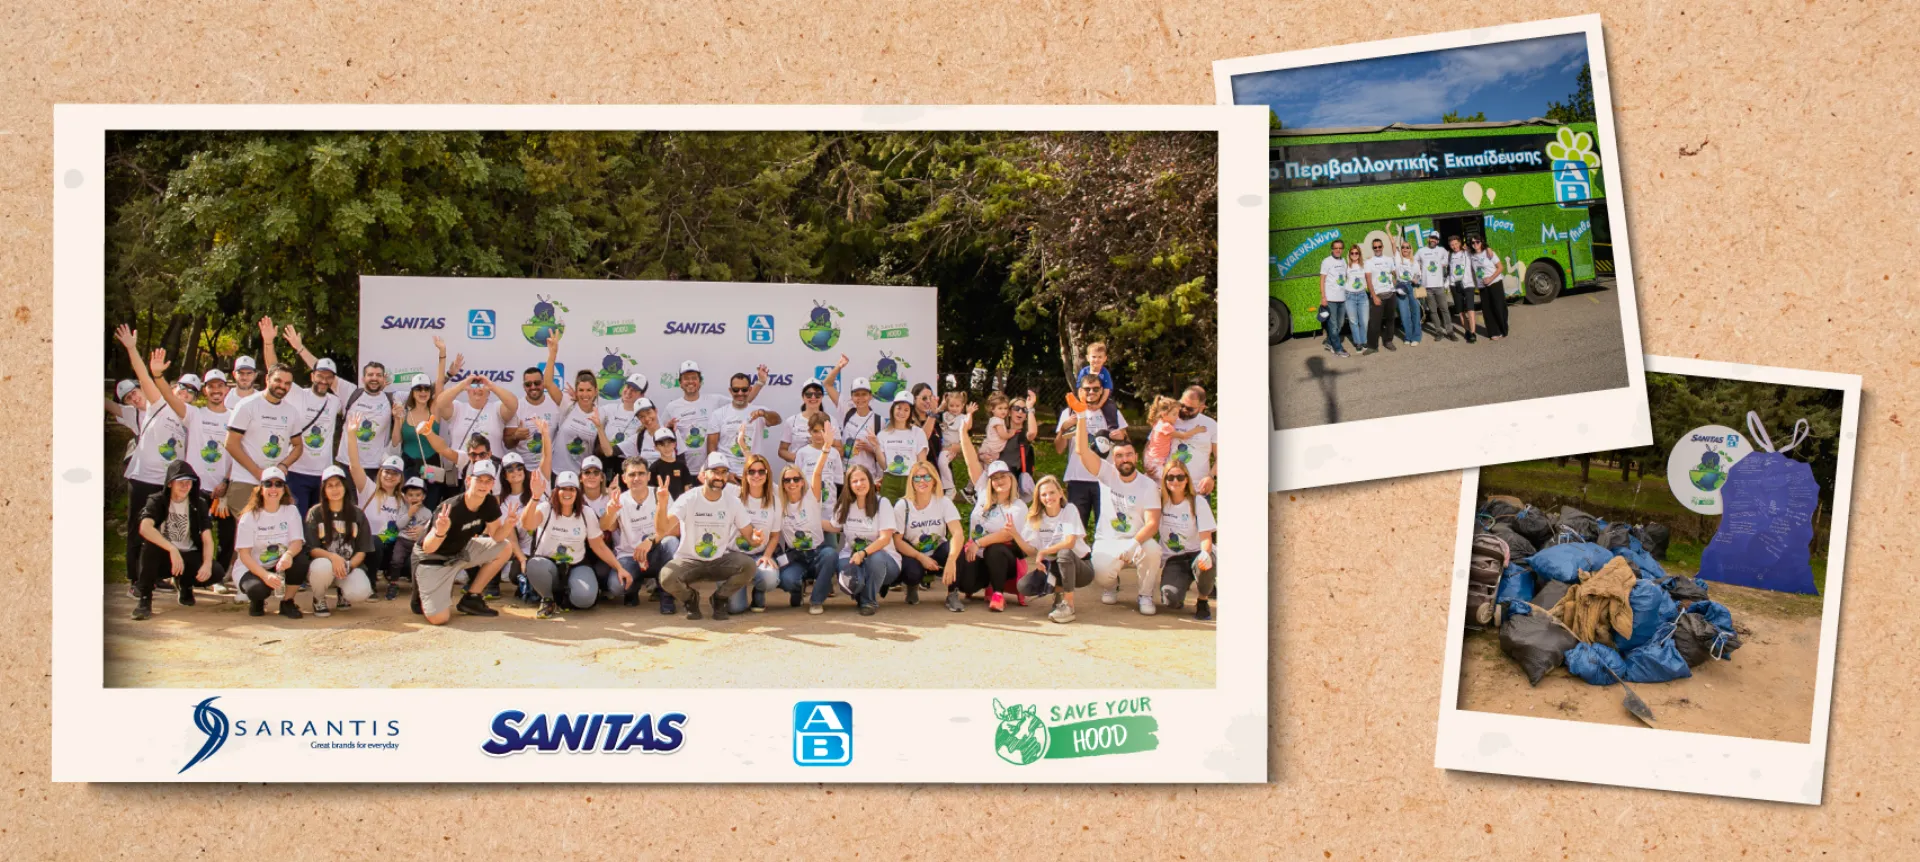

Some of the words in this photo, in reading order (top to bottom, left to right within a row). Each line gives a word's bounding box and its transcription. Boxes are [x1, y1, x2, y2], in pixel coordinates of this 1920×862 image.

[1285, 153, 1438, 180] Περιβαλλοντικής
[1443, 150, 1543, 169] Εκπαίδευσης
[381, 316, 446, 330] SANITAS
[663, 321, 726, 335] SANITAS
[1691, 434, 1725, 443] SANITAS
[910, 518, 942, 529] SANITAS
